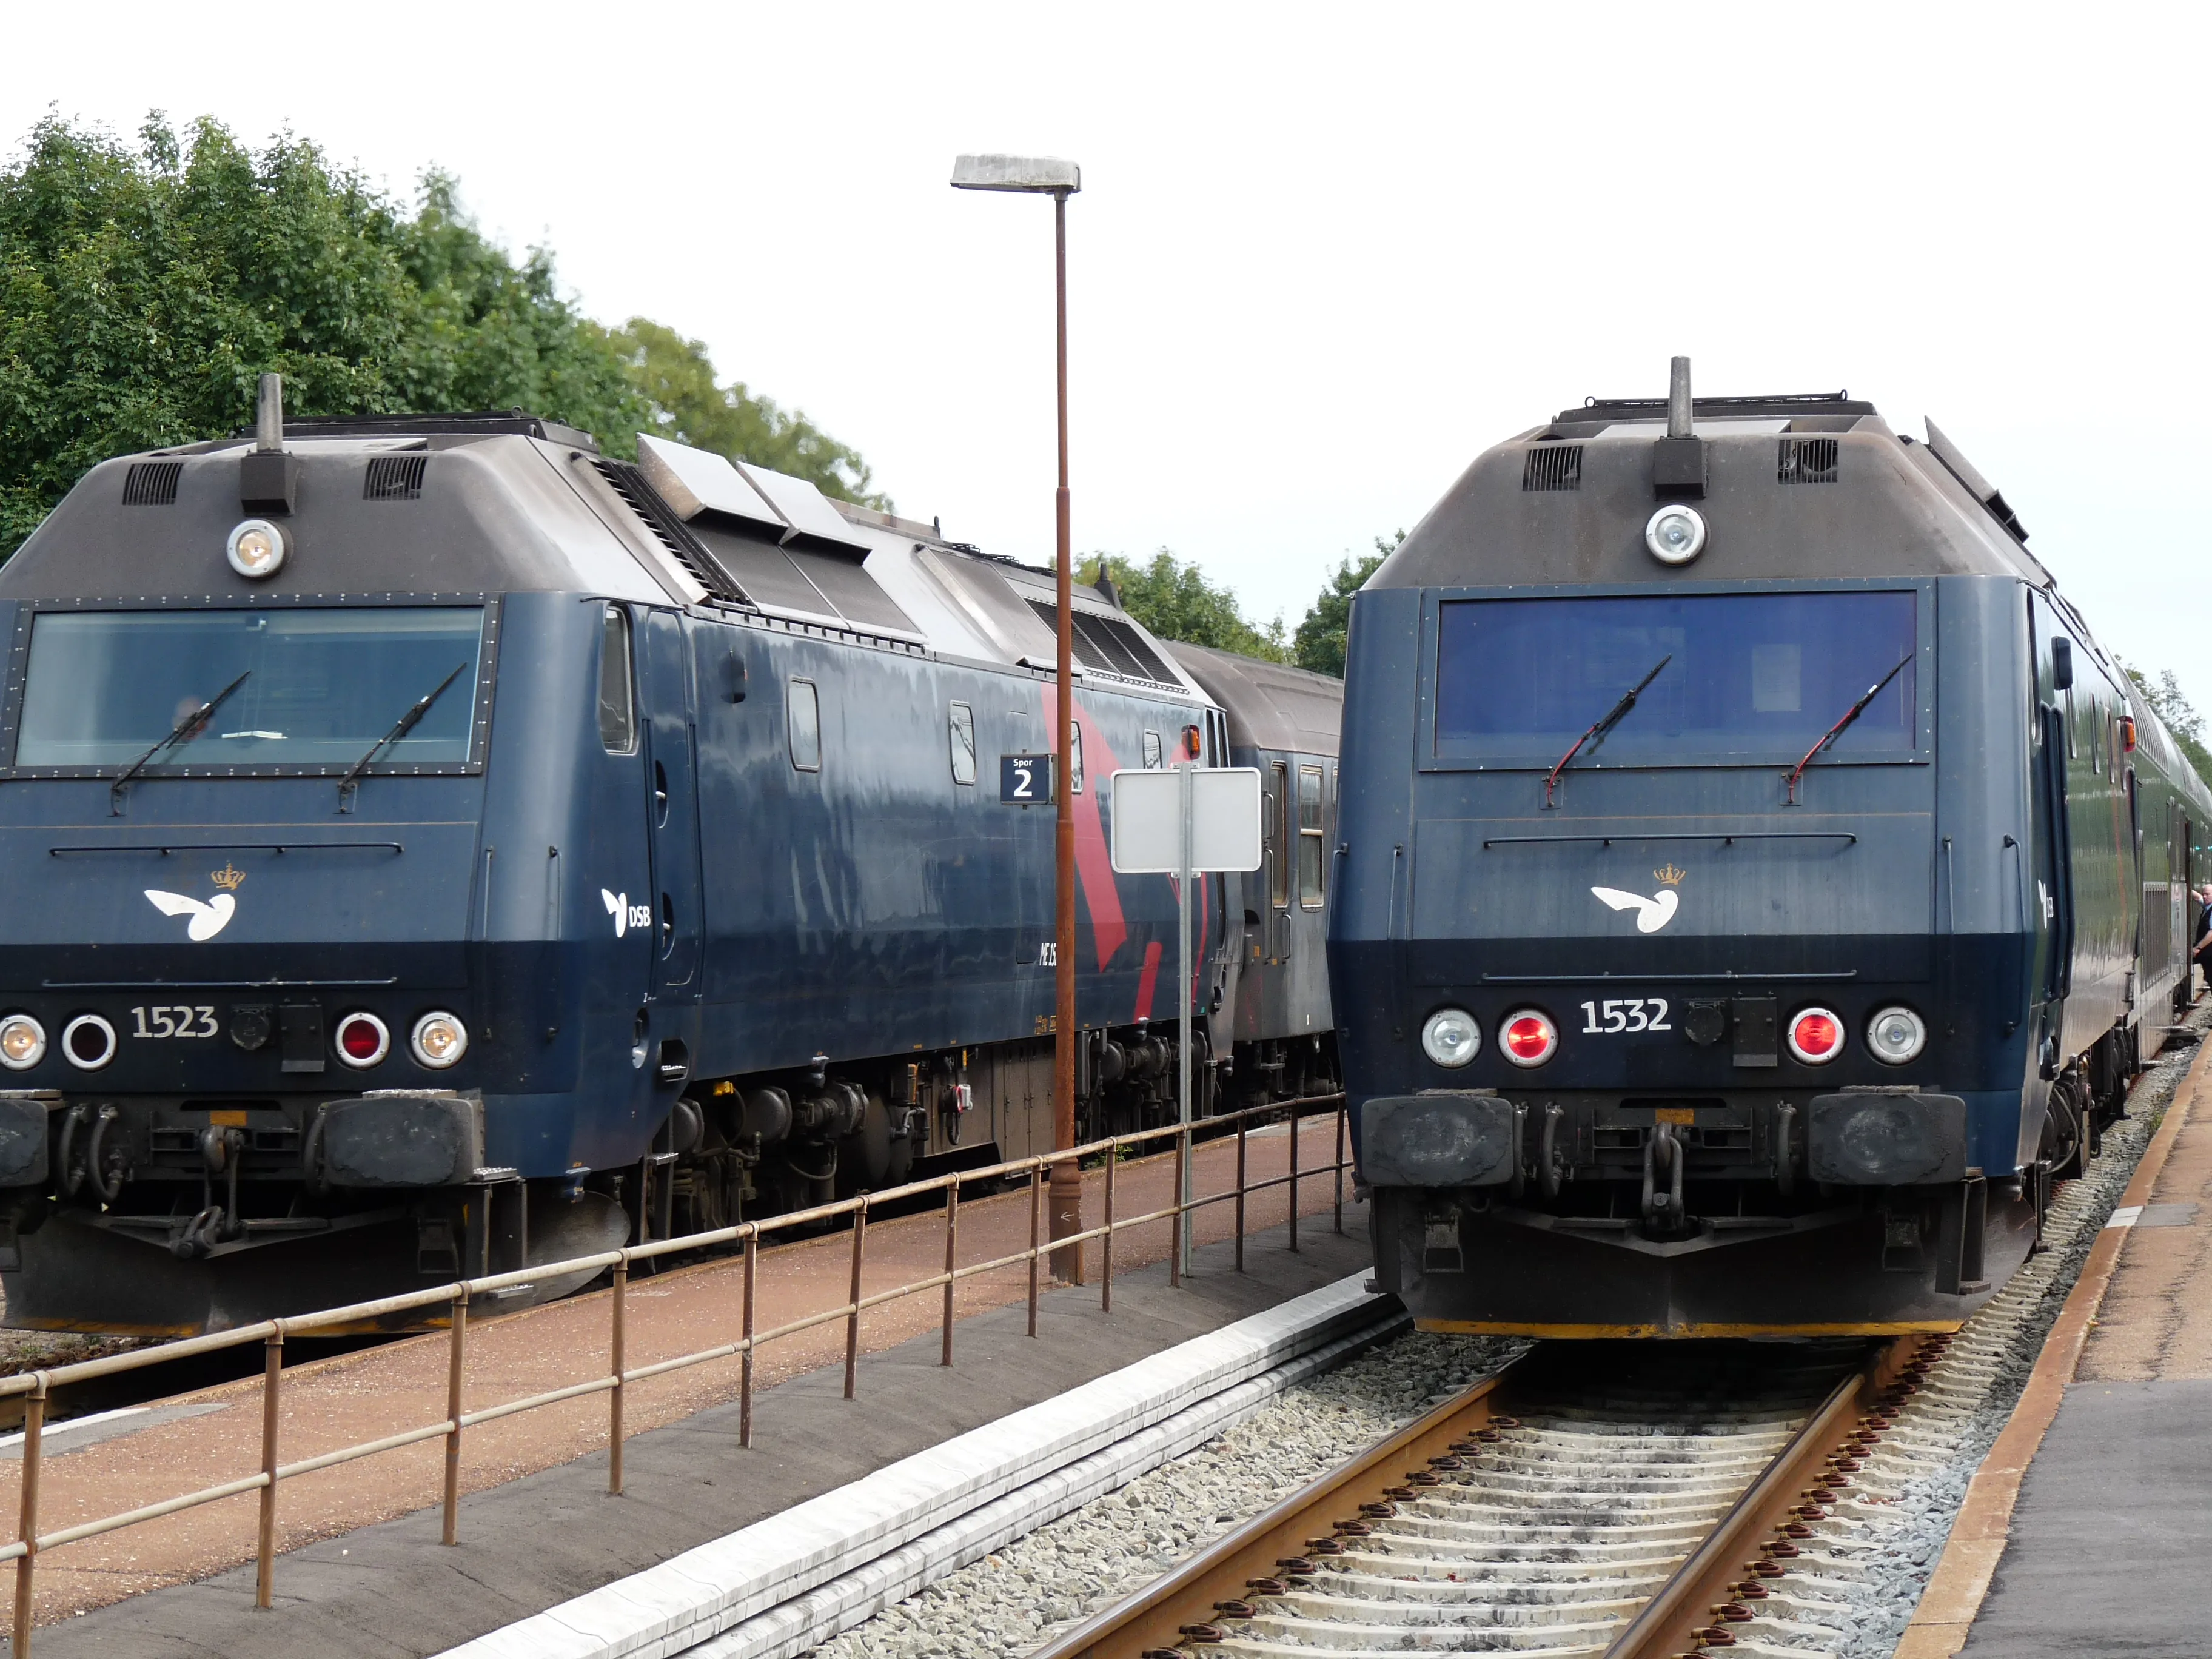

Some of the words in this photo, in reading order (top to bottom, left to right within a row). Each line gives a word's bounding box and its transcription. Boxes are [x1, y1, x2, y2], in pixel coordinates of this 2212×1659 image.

[1013, 759, 1033, 768] Spor
[1014, 769, 1033, 797] 2
[628, 905, 651, 927] DSB
[1048, 942, 1057, 967] 15
[131, 1005, 219, 1038] 1523
[1581, 998, 1672, 1033] 1532
